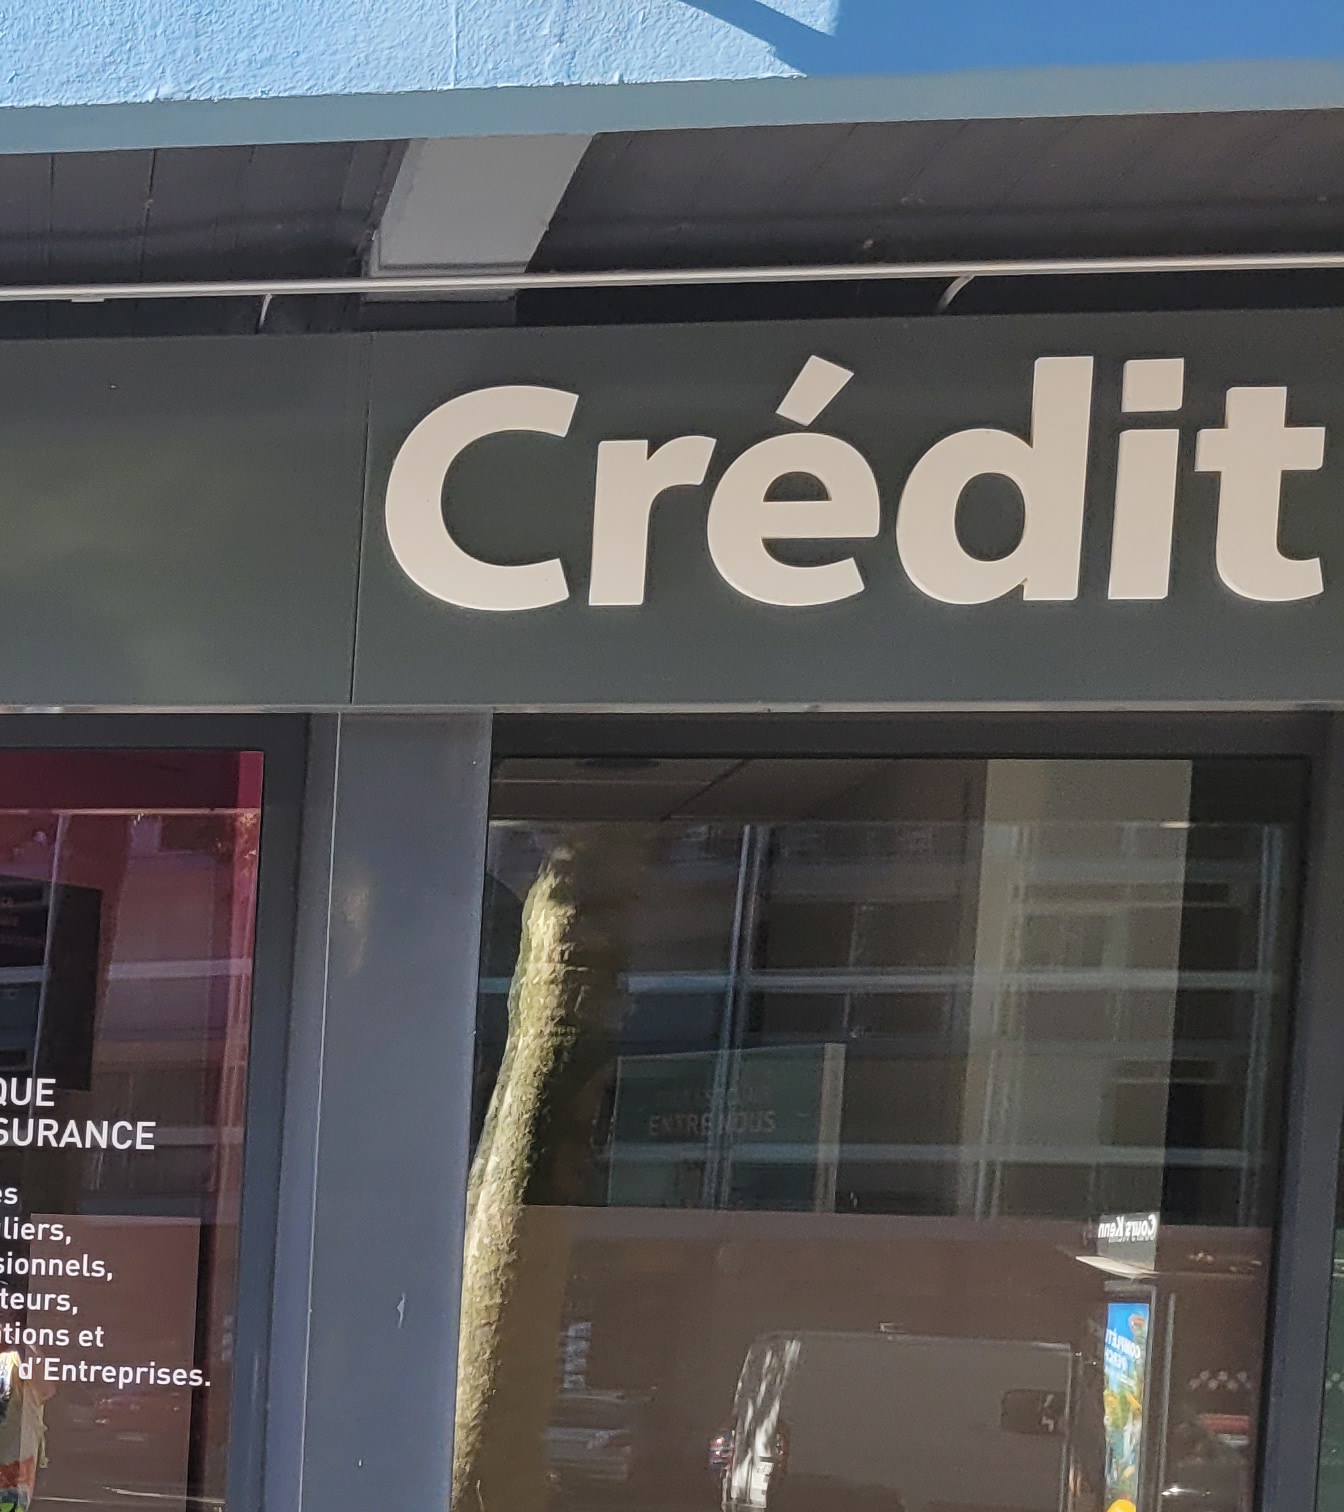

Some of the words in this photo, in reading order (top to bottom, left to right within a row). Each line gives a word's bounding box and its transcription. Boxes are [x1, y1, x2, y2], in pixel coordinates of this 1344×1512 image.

[384, 354, 1326, 612] Crédit
[78, 1325, 104, 1348] et
[18, 1356, 211, 1388] d'Entreprises.
